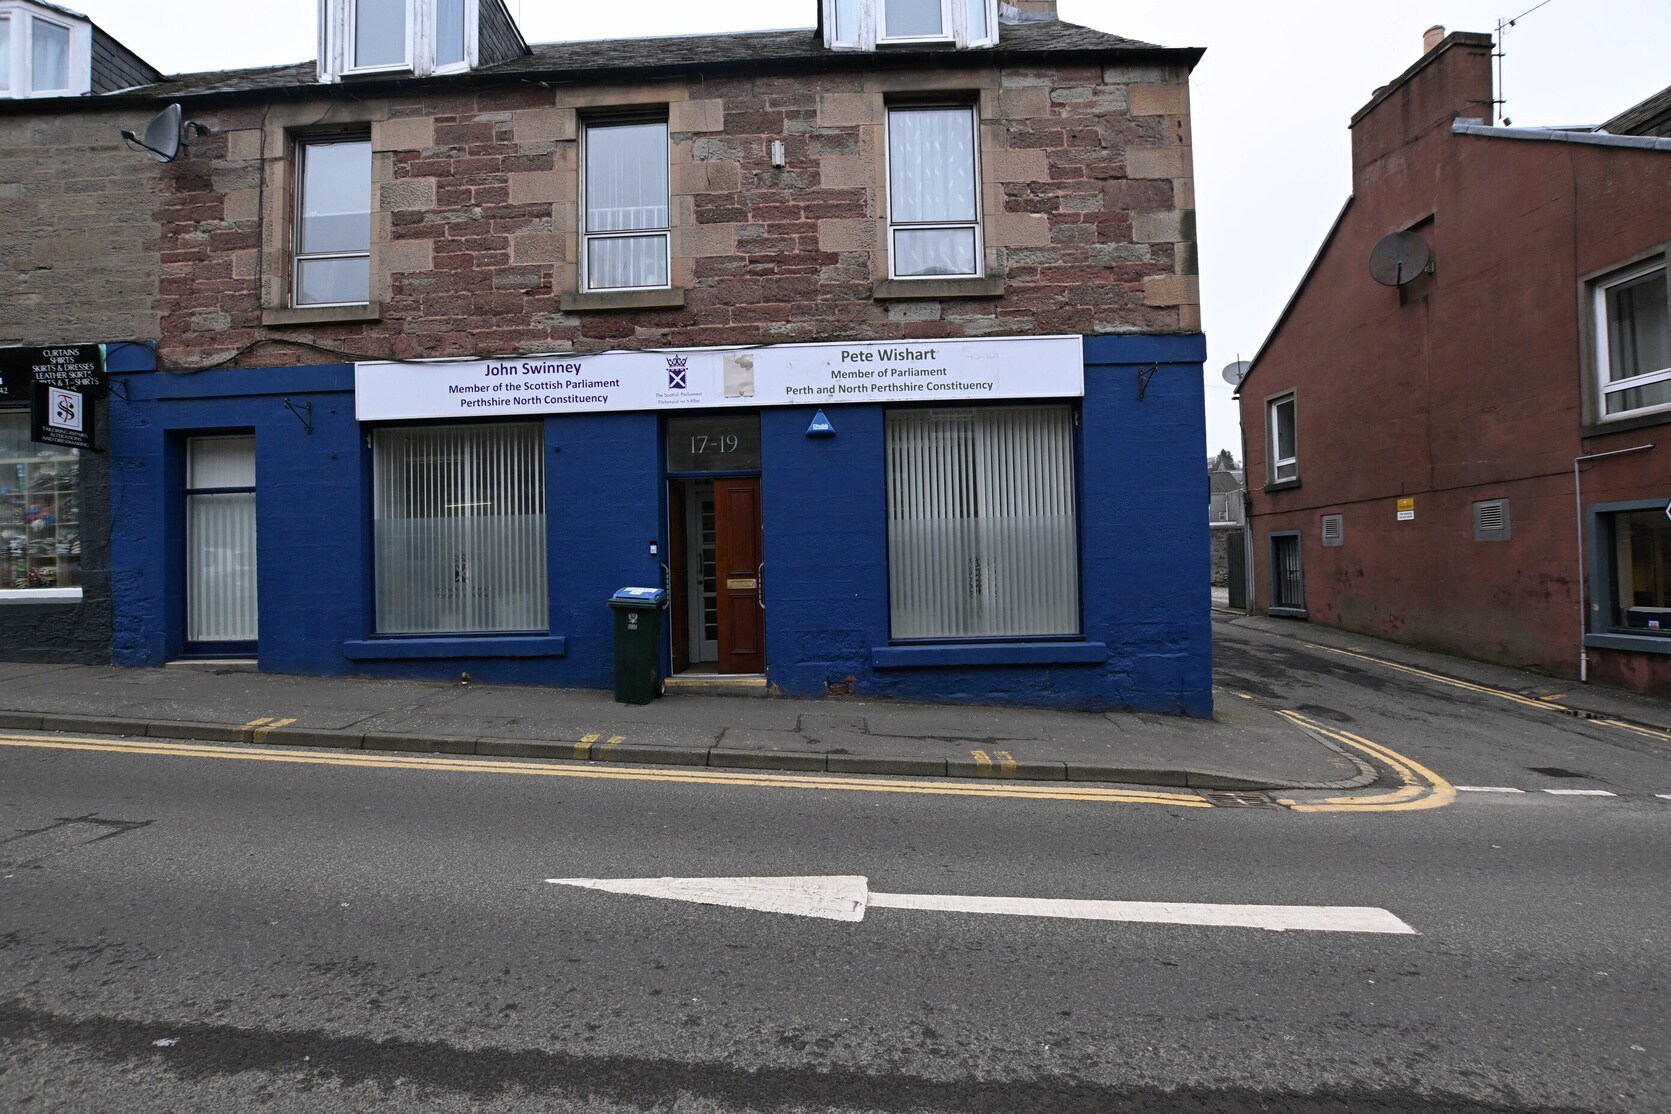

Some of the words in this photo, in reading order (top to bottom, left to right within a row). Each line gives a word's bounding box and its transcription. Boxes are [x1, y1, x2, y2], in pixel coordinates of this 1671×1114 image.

[42, 349, 80, 357] CURTAINS
[50, 356, 75, 364] SHIRTS
[841, 350, 873, 363] Pete
[877, 347, 936, 362] Wishart
[32, 364, 56, 372] SKIRTS
[64, 363, 95, 371] DRESSES
[485, 363, 518, 377] John
[522, 361, 582, 376] Swinney
[831, 369, 874, 379] Member
[877, 368, 889, 378] of
[891, 367, 947, 377] Parliament
[35, 372, 68, 380] LEATHER
[448, 383, 490, 394] Member
[492, 382, 504, 392] of
[505, 381, 522, 392] the
[524, 380, 563, 391] Scottish
[565, 379, 620, 389] Parliament
[786, 385, 814, 395] Perth
[816, 383, 836, 394] and
[838, 383, 868, 393] North
[870, 381, 924, 392] Perthshire
[926, 380, 994, 391] Constituency
[460, 397, 511, 407] Perthshire
[513, 396, 542, 405] North
[544, 393, 608, 404] Constituency
[691, 434, 738, 454] 17-19
